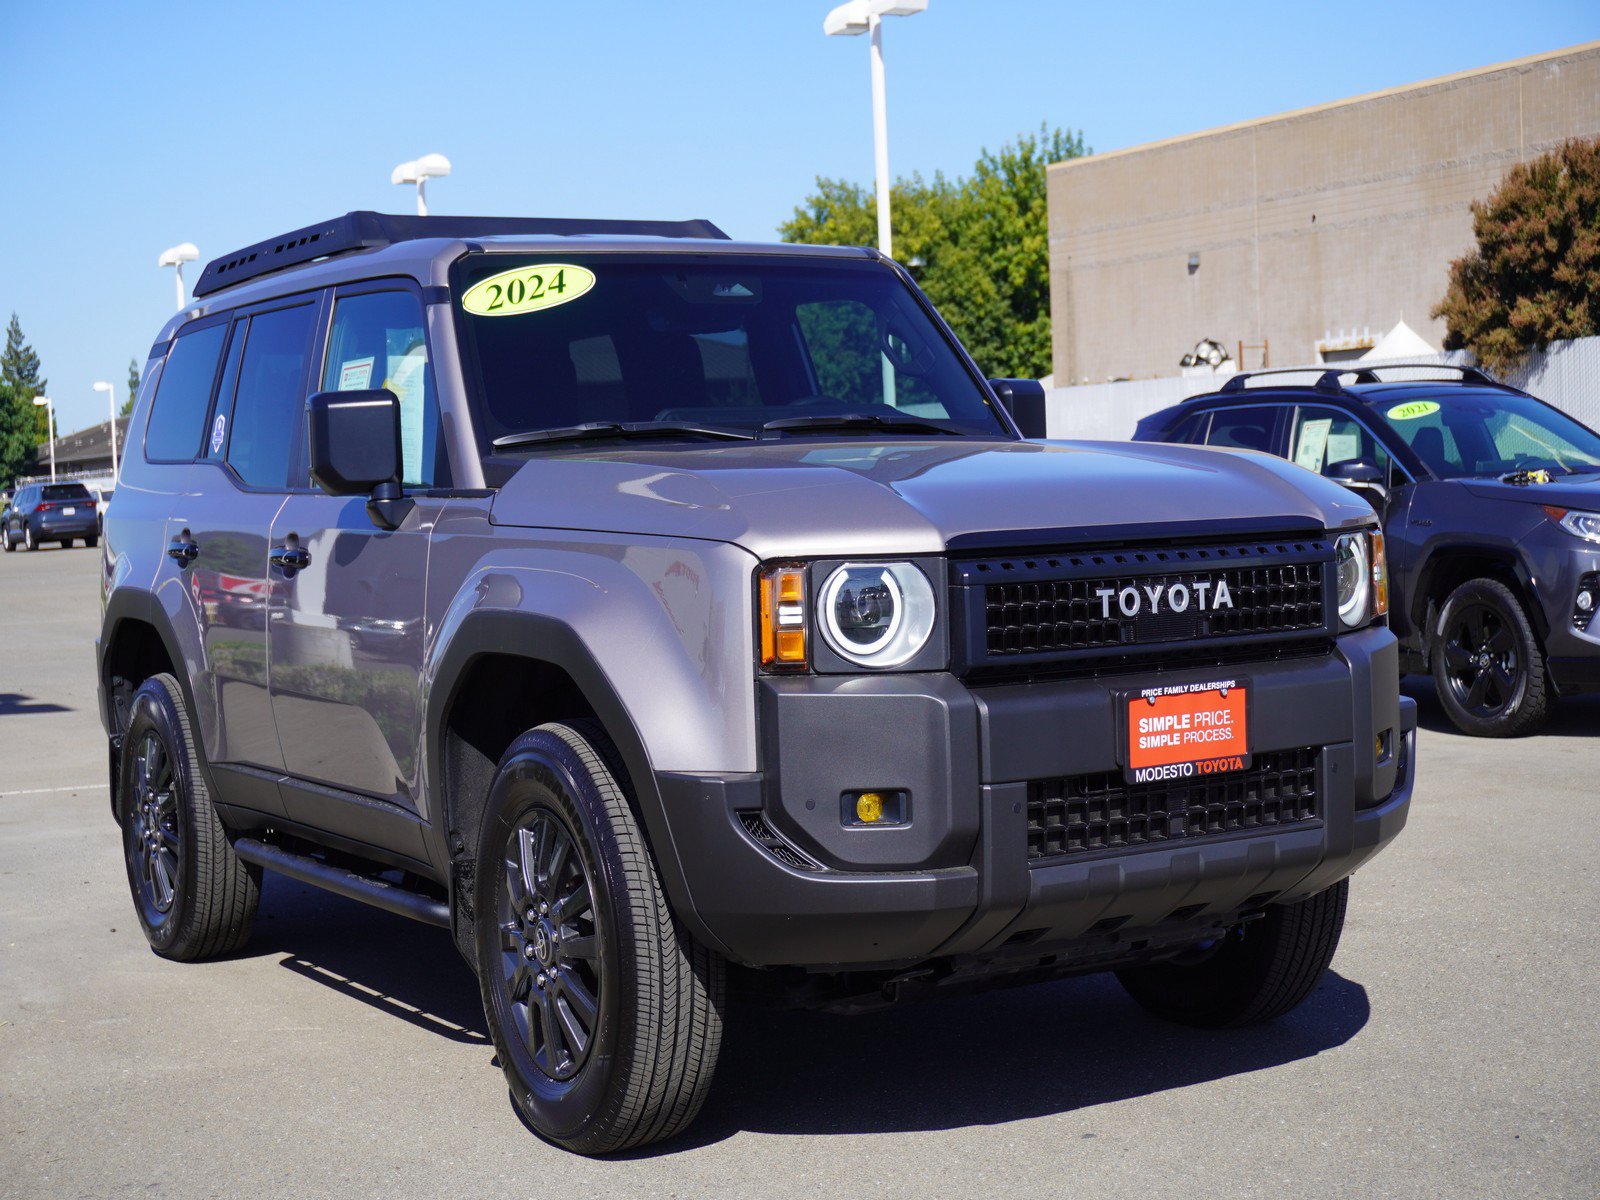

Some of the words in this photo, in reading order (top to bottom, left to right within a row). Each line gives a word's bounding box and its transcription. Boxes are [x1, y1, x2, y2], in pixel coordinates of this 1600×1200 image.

[486, 269, 566, 311] 2024
[1398, 403, 1429, 418] 2021
[1096, 580, 1234, 618] TOYOTA
[1141, 688, 1162, 697] PRICE
[1163, 685, 1189, 695] FAMILY
[1190, 680, 1236, 692] DEALERSHIPS
[1139, 714, 1191, 733] SIMPLE
[1194, 709, 1234, 727] PRICE.
[1139, 733, 1180, 749] SIMPLE
[1183, 727, 1234, 744] PROCESS.
[1135, 763, 1193, 783] MODESTO
[1196, 757, 1243, 774] TOYOTA
